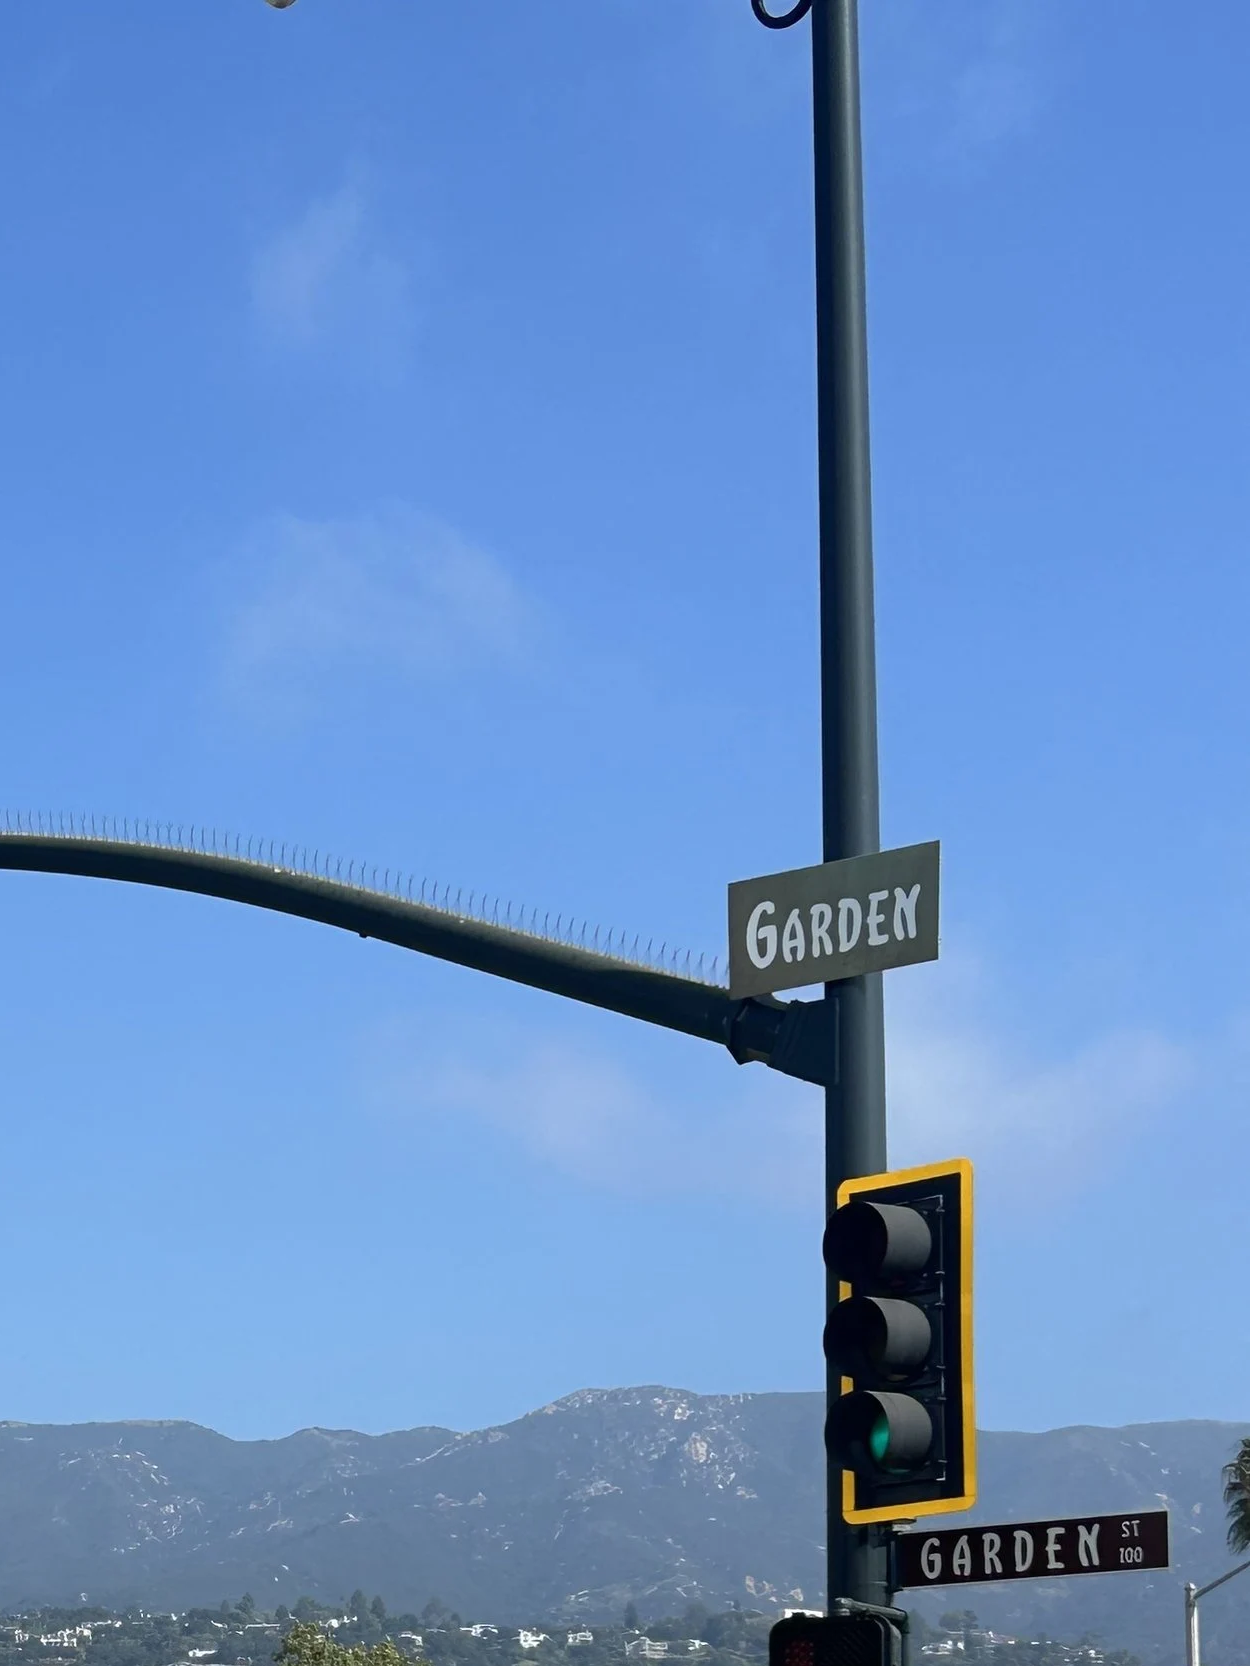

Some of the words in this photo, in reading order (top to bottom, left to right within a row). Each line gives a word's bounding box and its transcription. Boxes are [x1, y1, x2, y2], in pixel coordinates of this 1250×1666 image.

[746, 883, 921, 969] GARDEN
[920, 1523, 1099, 1579] GARDEN
[1121, 1520, 1140, 1538] ST
[1119, 1546, 1143, 1564] 100
